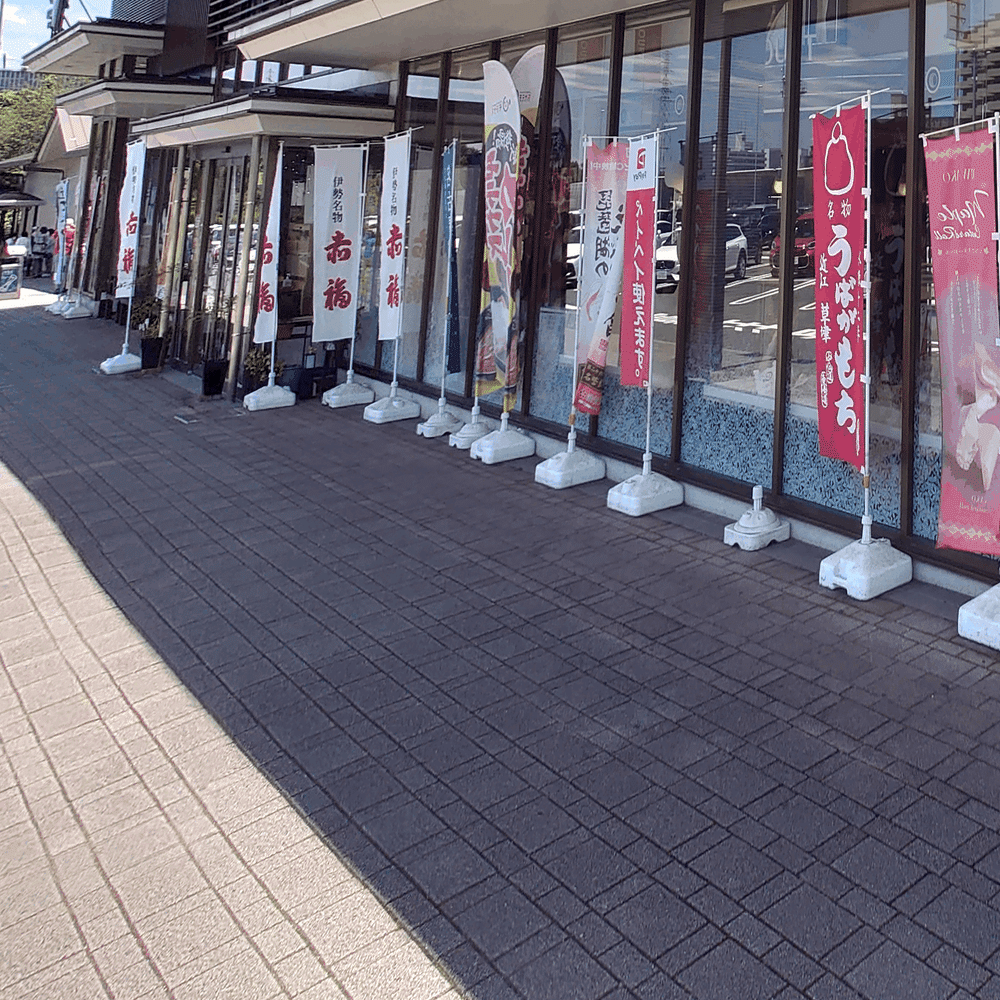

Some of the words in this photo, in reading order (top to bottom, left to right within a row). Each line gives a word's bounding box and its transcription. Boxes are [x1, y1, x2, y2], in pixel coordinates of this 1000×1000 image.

[332, 176, 344, 223] 伊勢名物
[827, 198, 852, 220] 名物
[323, 230, 352, 311] 赤福
[819, 252, 829, 288] 近江
[820, 302, 832, 343] 草津
[827, 224, 857, 434] うばがもち
